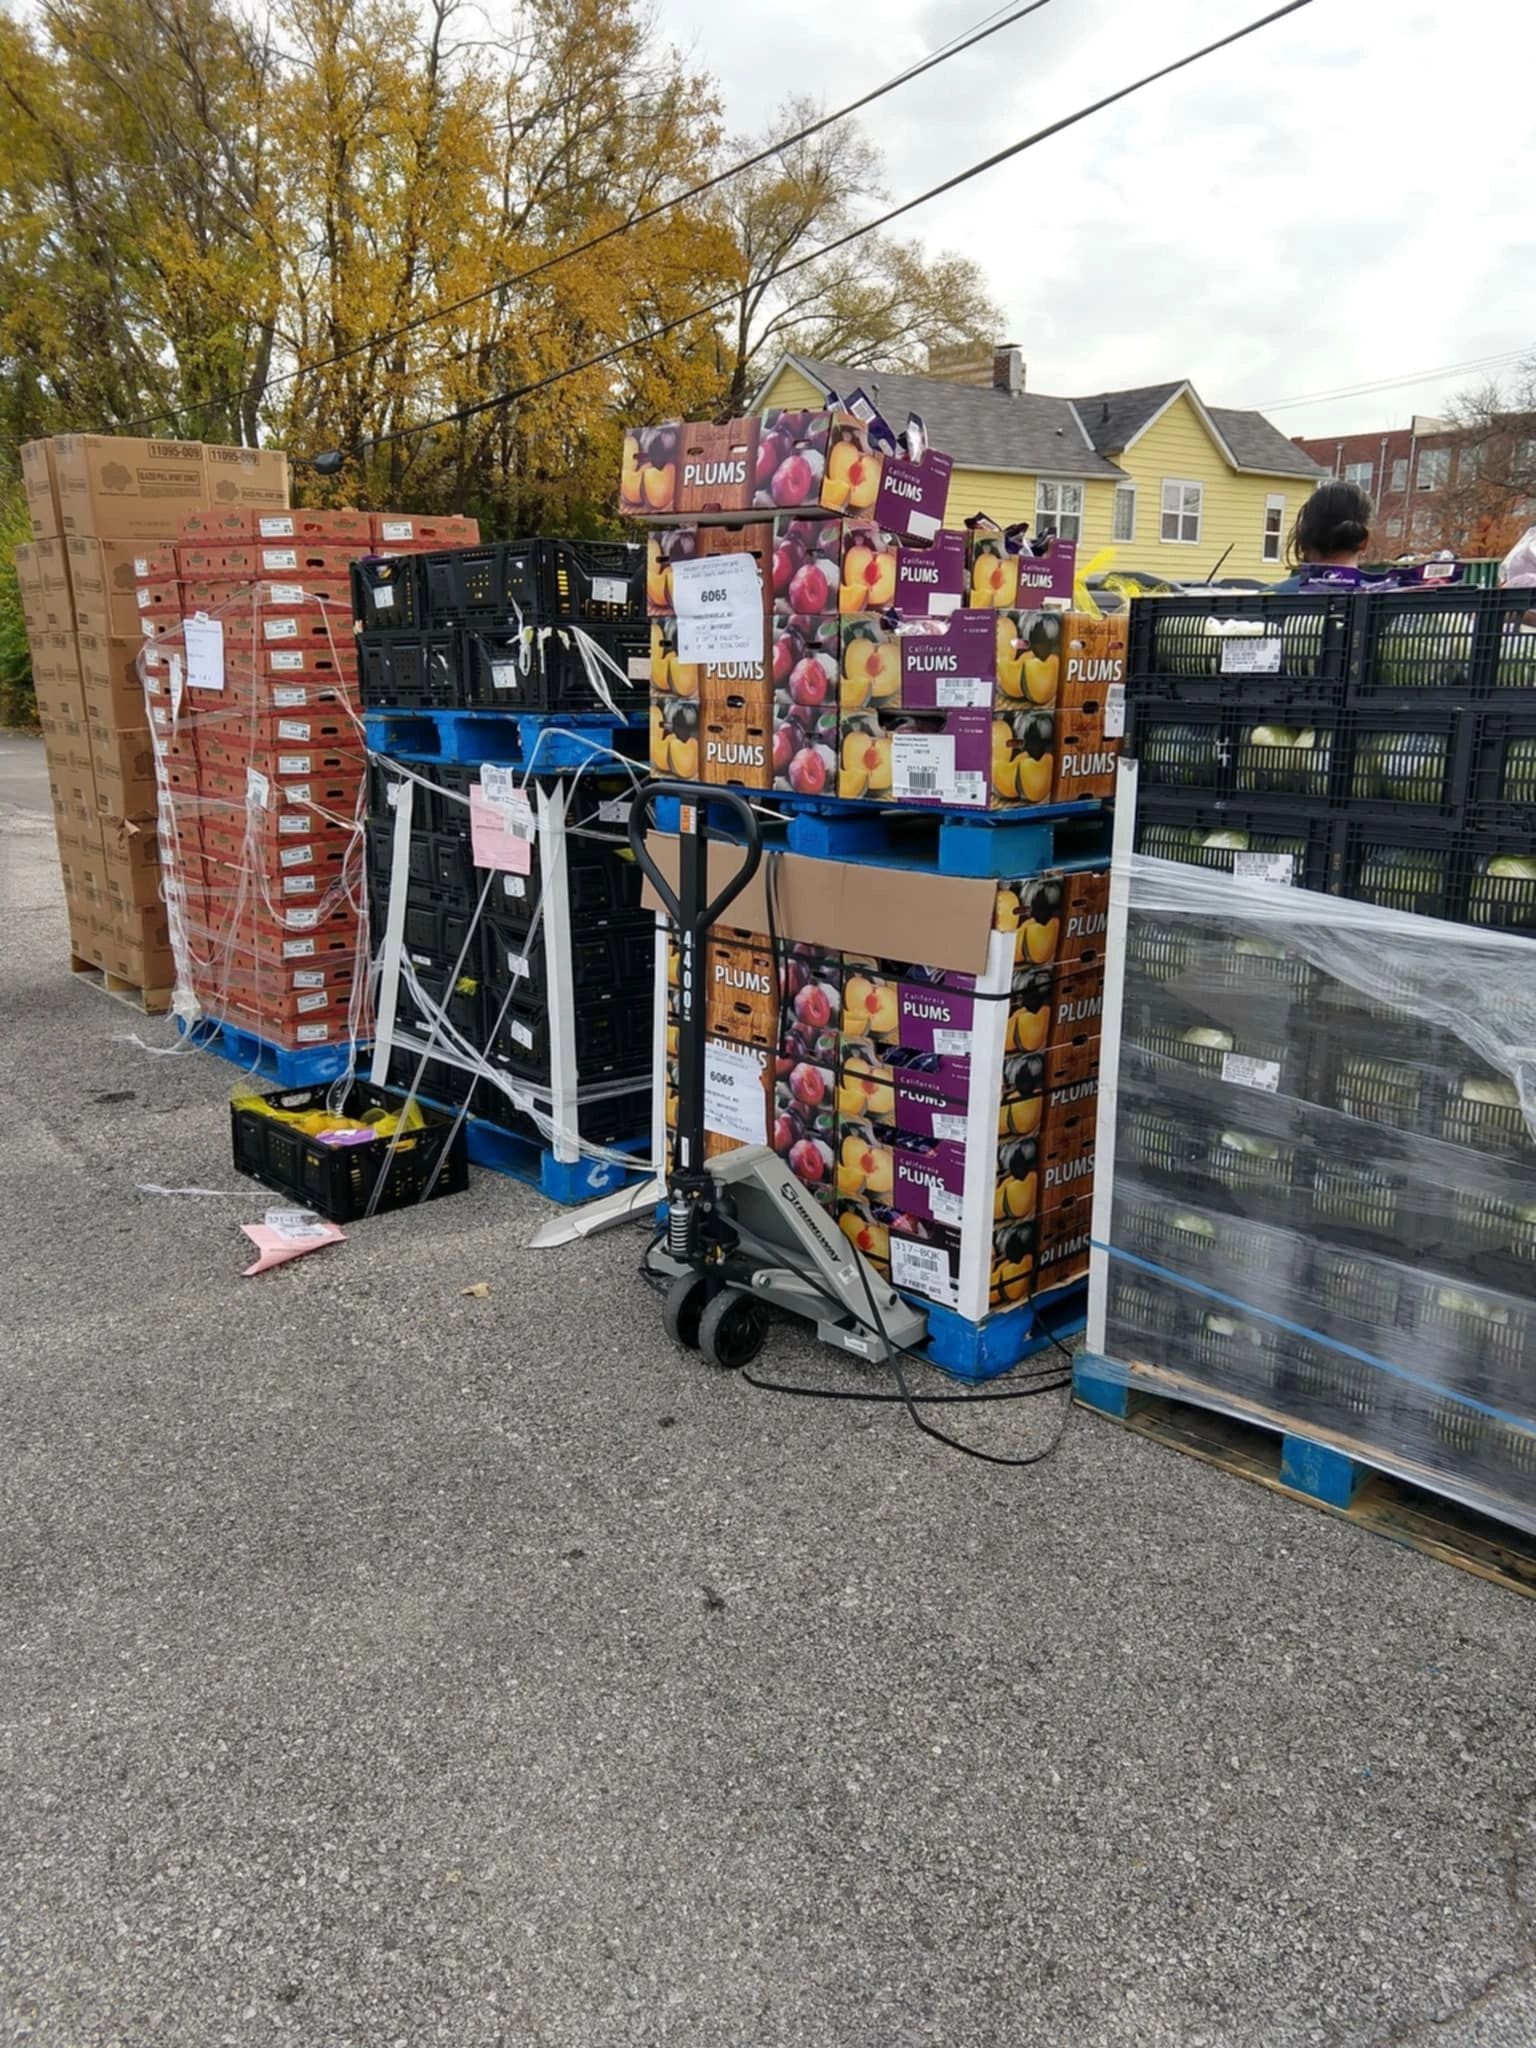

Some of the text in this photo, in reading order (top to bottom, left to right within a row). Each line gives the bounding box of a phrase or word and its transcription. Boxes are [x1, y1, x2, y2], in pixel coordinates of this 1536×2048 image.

[684, 461, 746, 486] PLUMS
[884, 475, 923, 502] PLUMS
[900, 566, 939, 583] PLUMS
[1020, 572, 1053, 588] PLUMS
[701, 589, 727, 602] 6065
[907, 655, 957, 671] PLUMS
[1067, 659, 1123, 682] PLUMS
[707, 742, 764, 766] PLUMS
[1061, 751, 1116, 777] PLUMS
[1066, 912, 1107, 938] PLUM
[683, 930, 692, 1009] 4400
[714, 965, 771, 994] PLUMS
[903, 1001, 951, 1022] PLUMS
[1057, 996, 1102, 1024] PLUM
[710, 1071, 734, 1086] 6065
[899, 1165, 945, 1192] PLUMS
[1044, 1153, 1095, 1189] PLUMS
